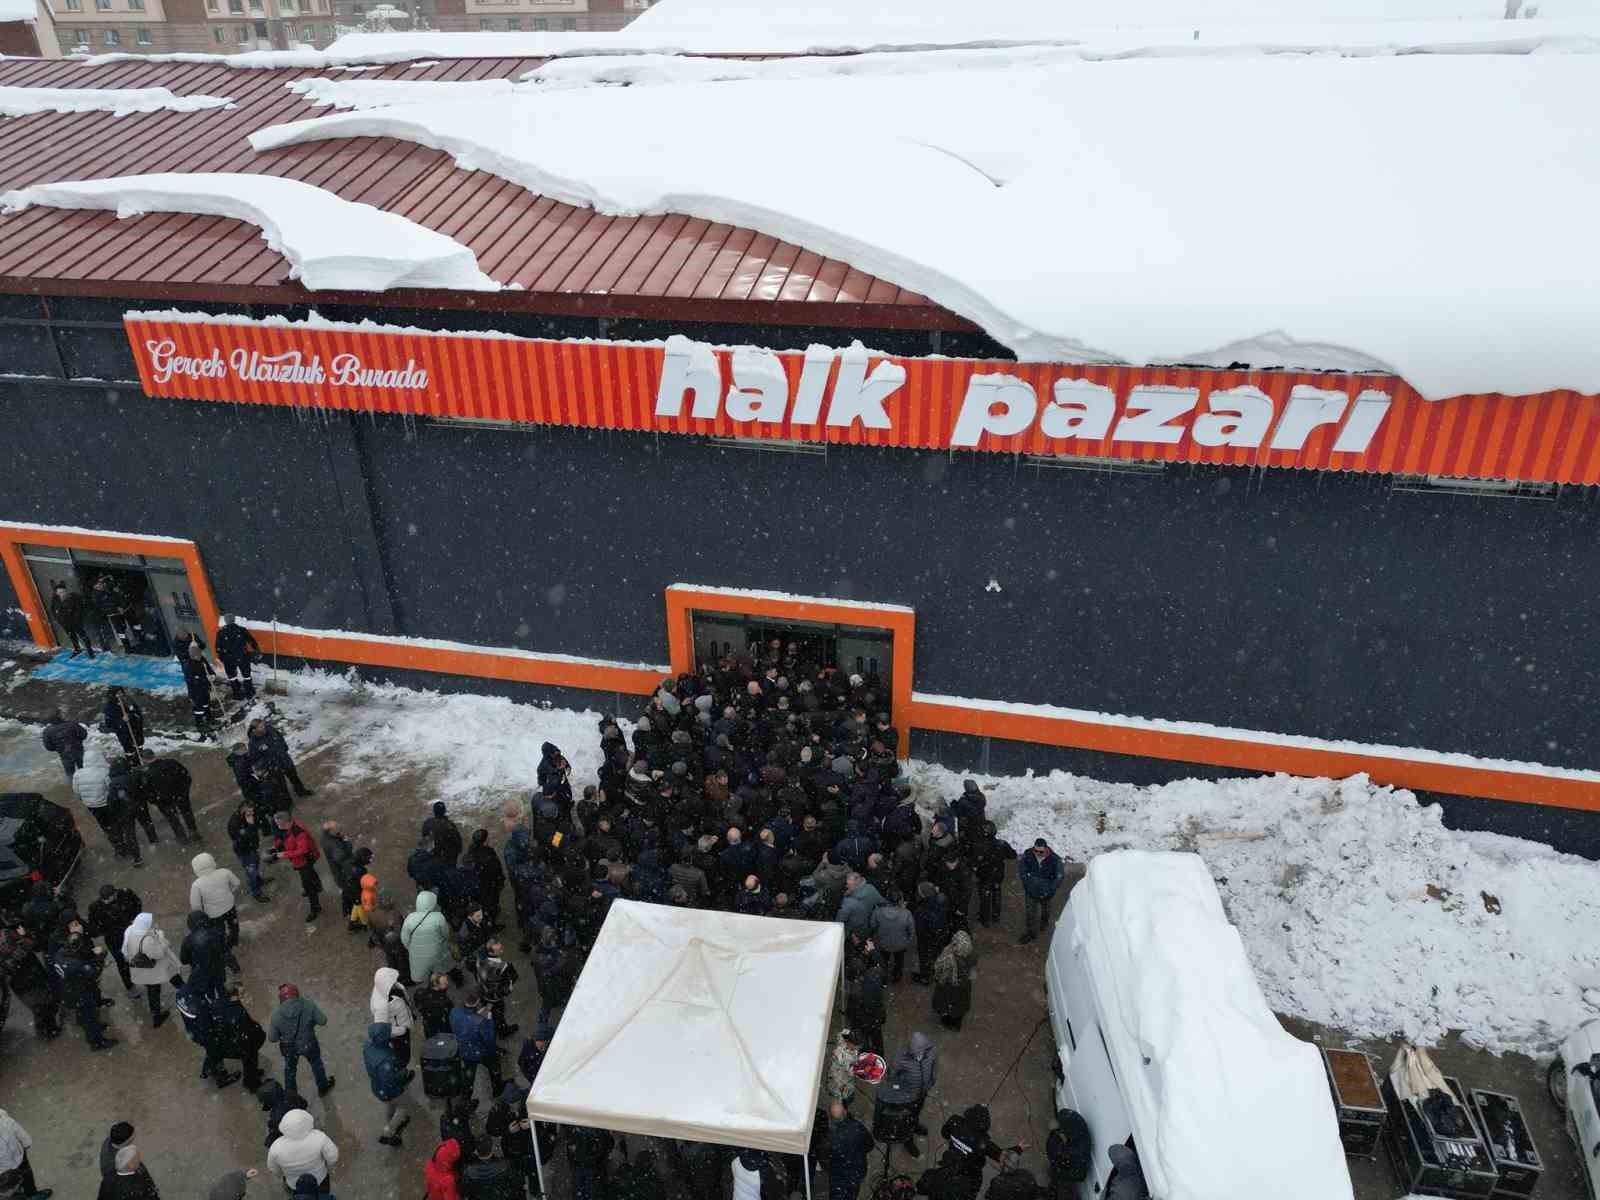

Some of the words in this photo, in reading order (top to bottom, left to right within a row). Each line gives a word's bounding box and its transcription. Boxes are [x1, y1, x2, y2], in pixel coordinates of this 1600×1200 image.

[146, 340, 227, 384] Gerçek
[230, 348, 326, 384] Ucuzluk
[331, 352, 429, 390] Burada
[656, 335, 906, 429] halk
[951, 374, 1392, 453] pazarı
